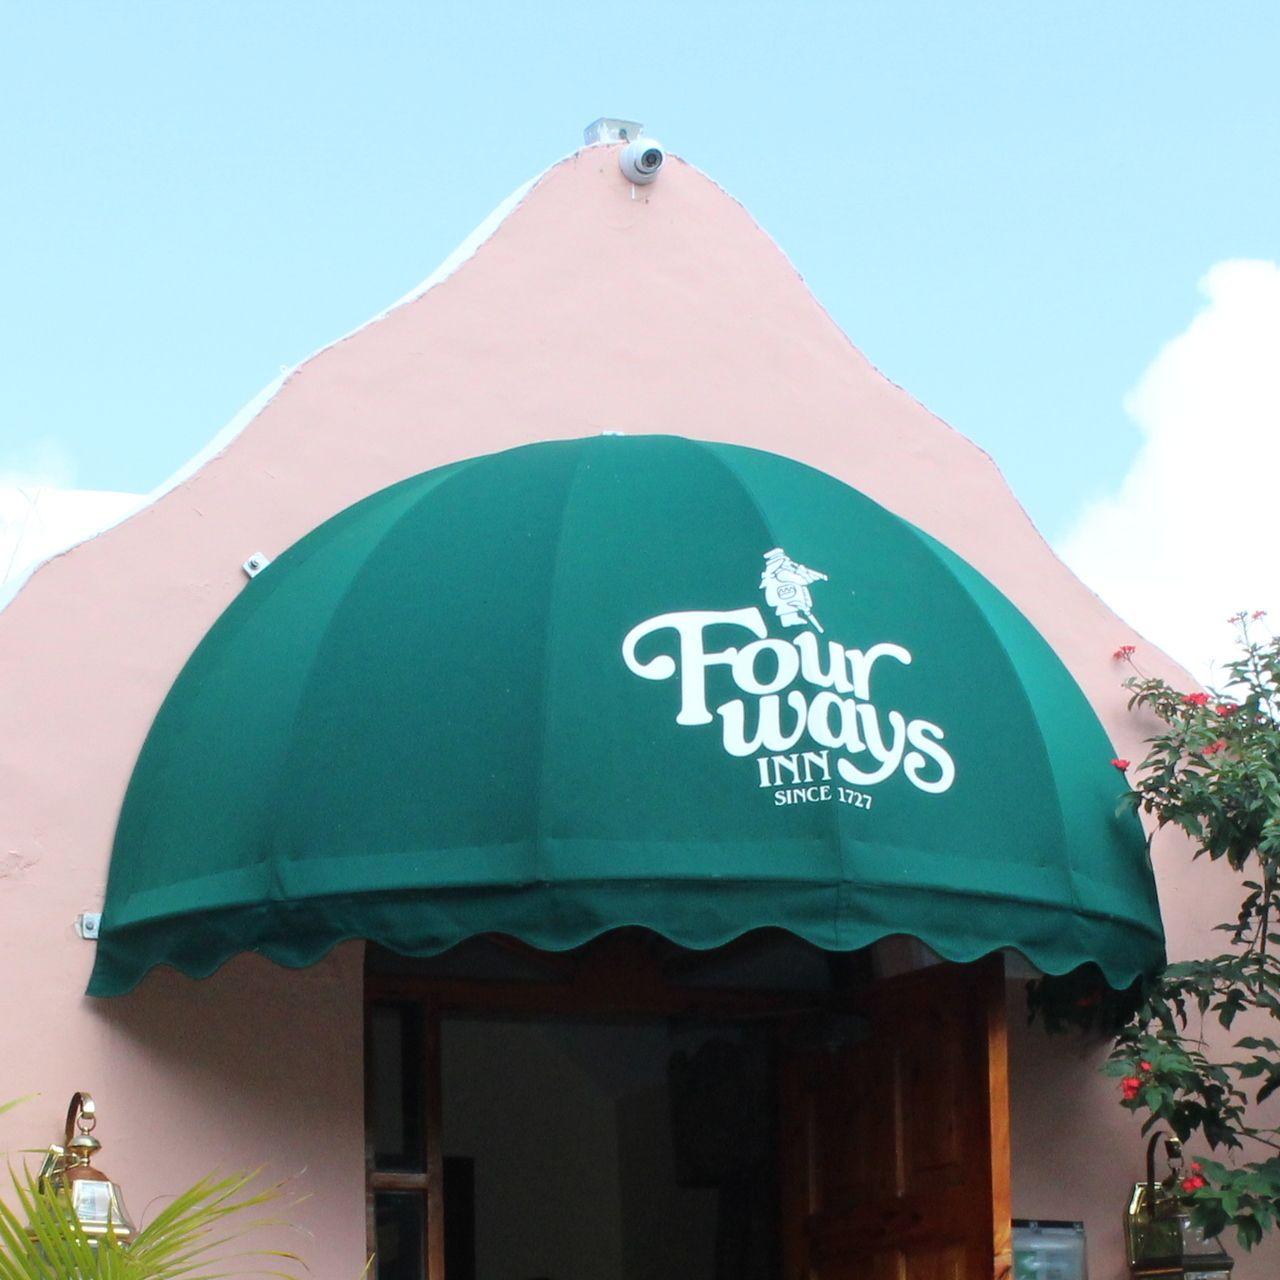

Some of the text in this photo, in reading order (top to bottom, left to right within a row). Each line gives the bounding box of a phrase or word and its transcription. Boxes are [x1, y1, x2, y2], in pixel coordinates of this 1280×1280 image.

[622, 606, 912, 725] Four
[756, 749, 832, 788] INN
[774, 785, 873, 810] SINCE 1727
